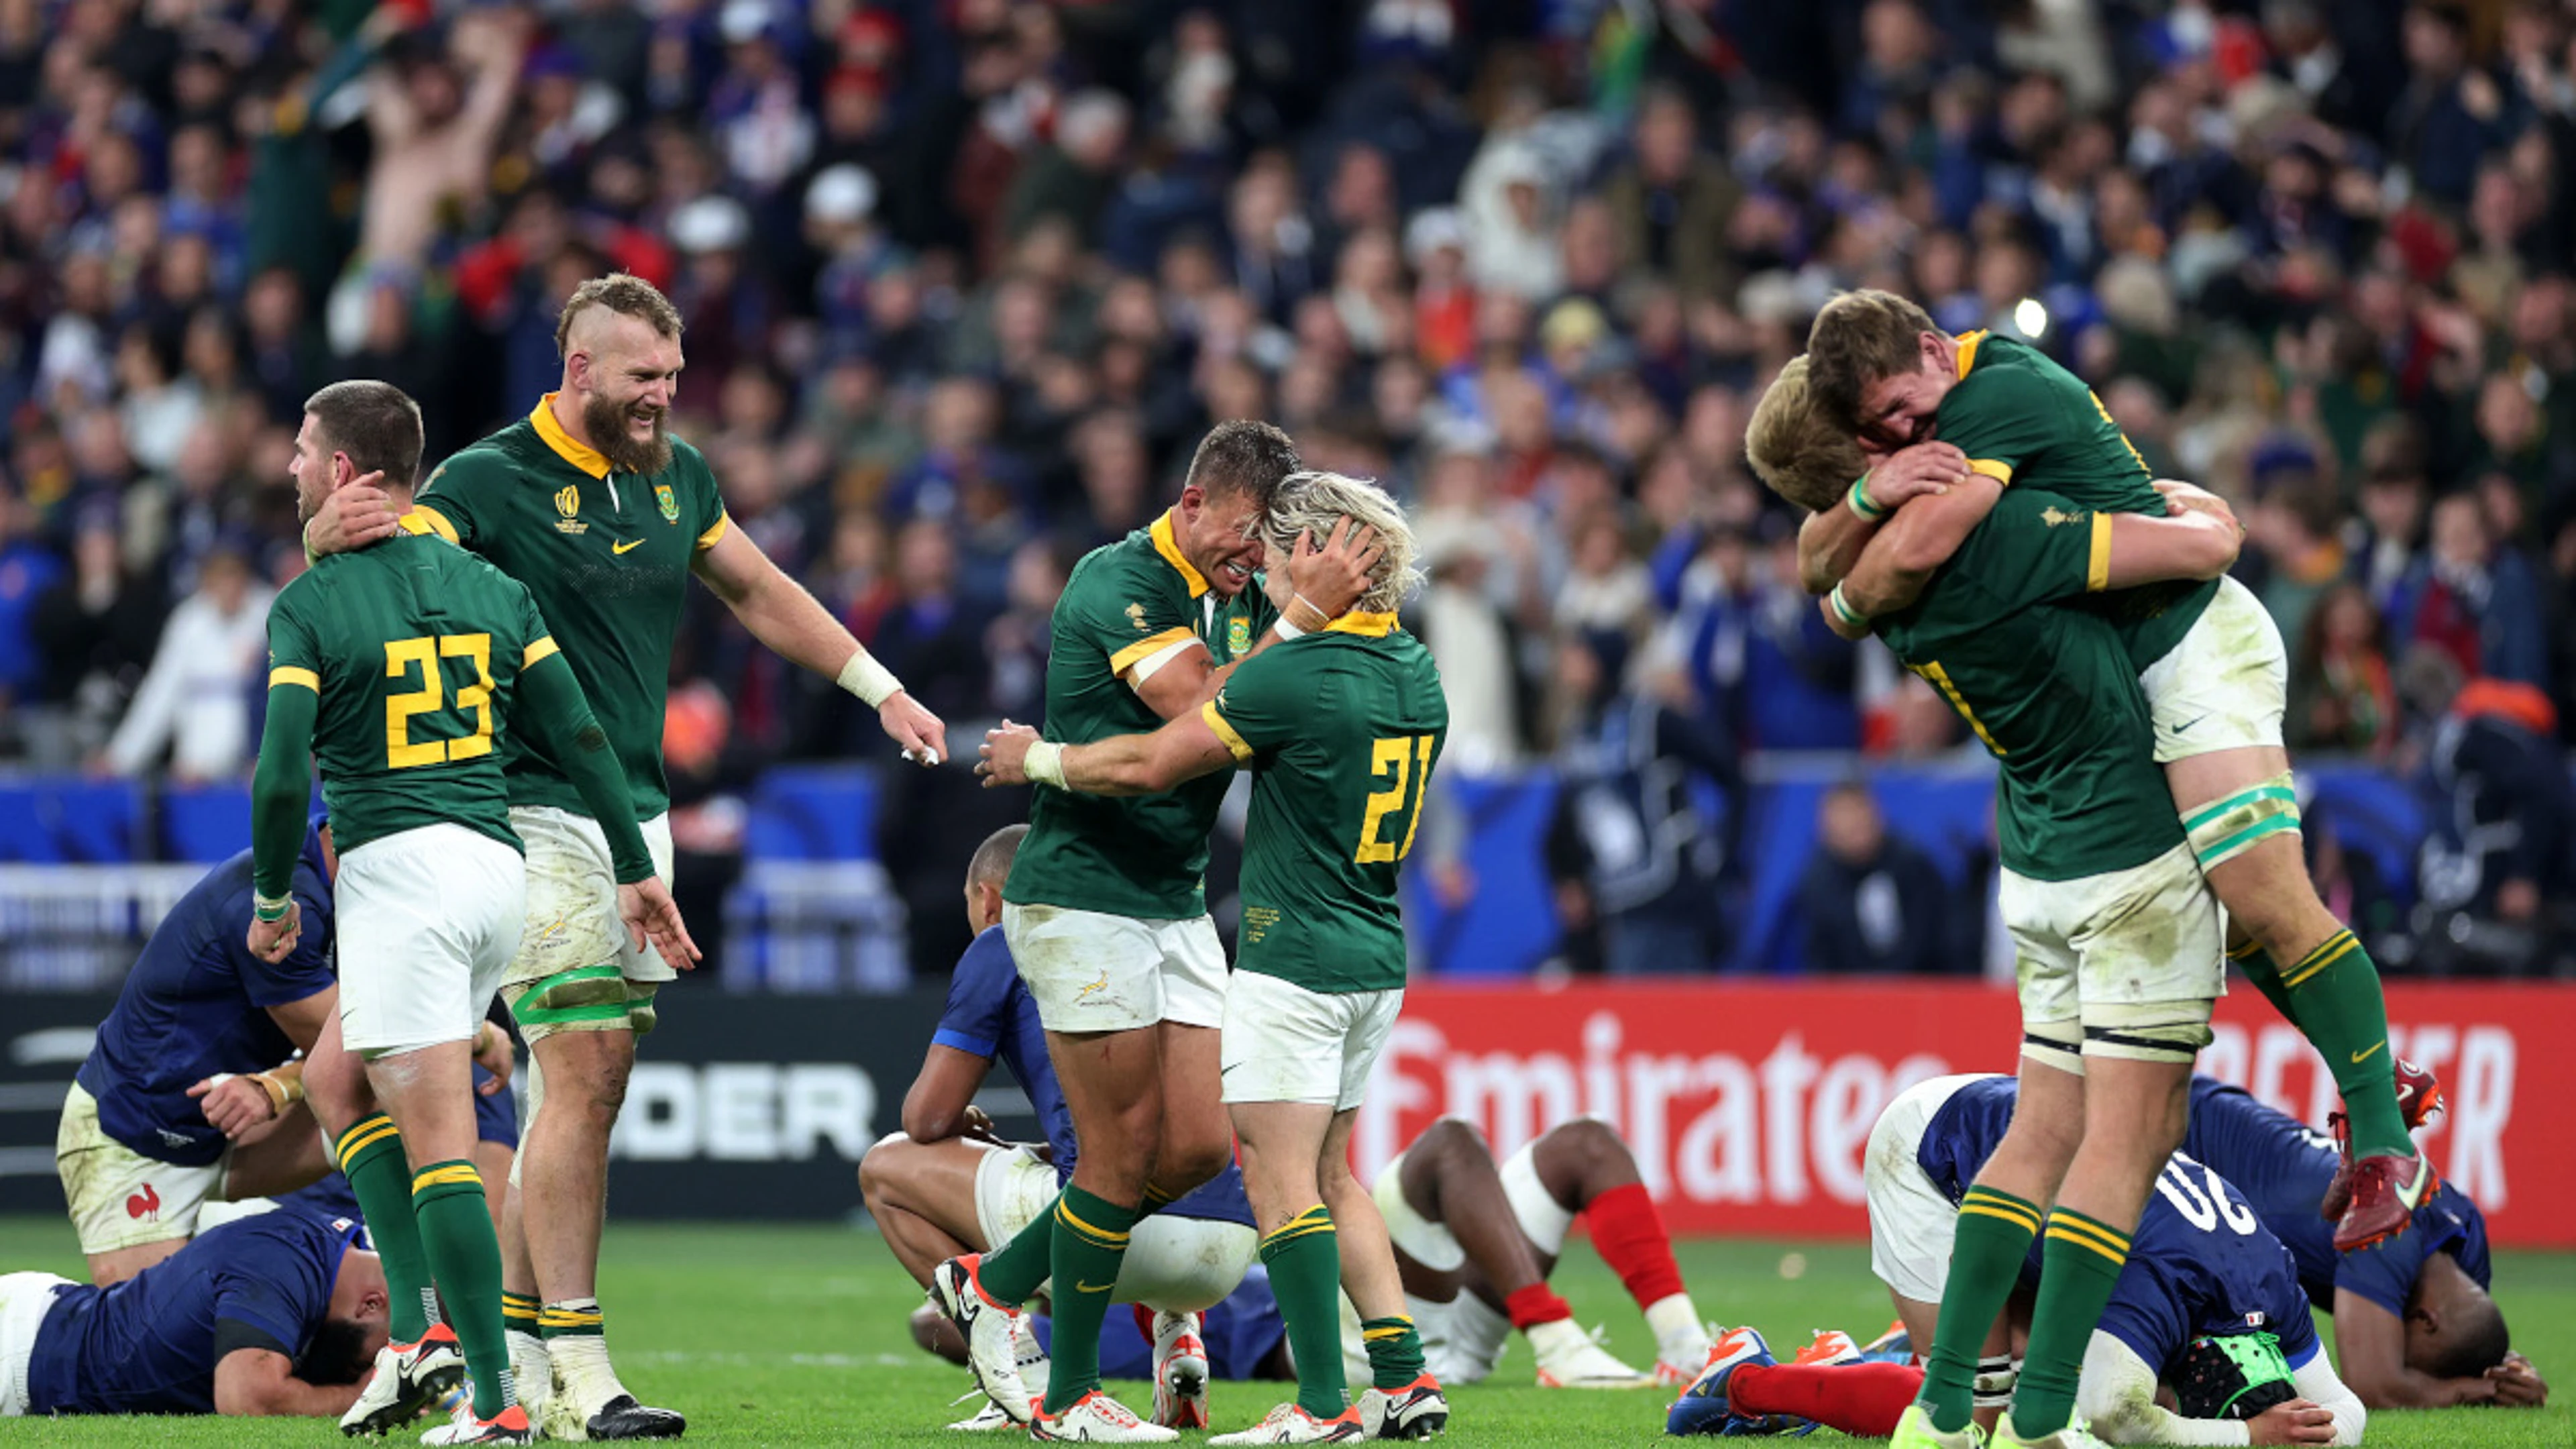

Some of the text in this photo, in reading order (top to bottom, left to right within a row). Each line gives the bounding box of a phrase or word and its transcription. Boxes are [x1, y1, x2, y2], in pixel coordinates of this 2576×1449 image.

[384, 633, 496, 769] 23
[1354, 735, 1435, 864] 21
[609, 1059, 877, 1162] DER
[1352, 1012, 1953, 1205] Emirate
